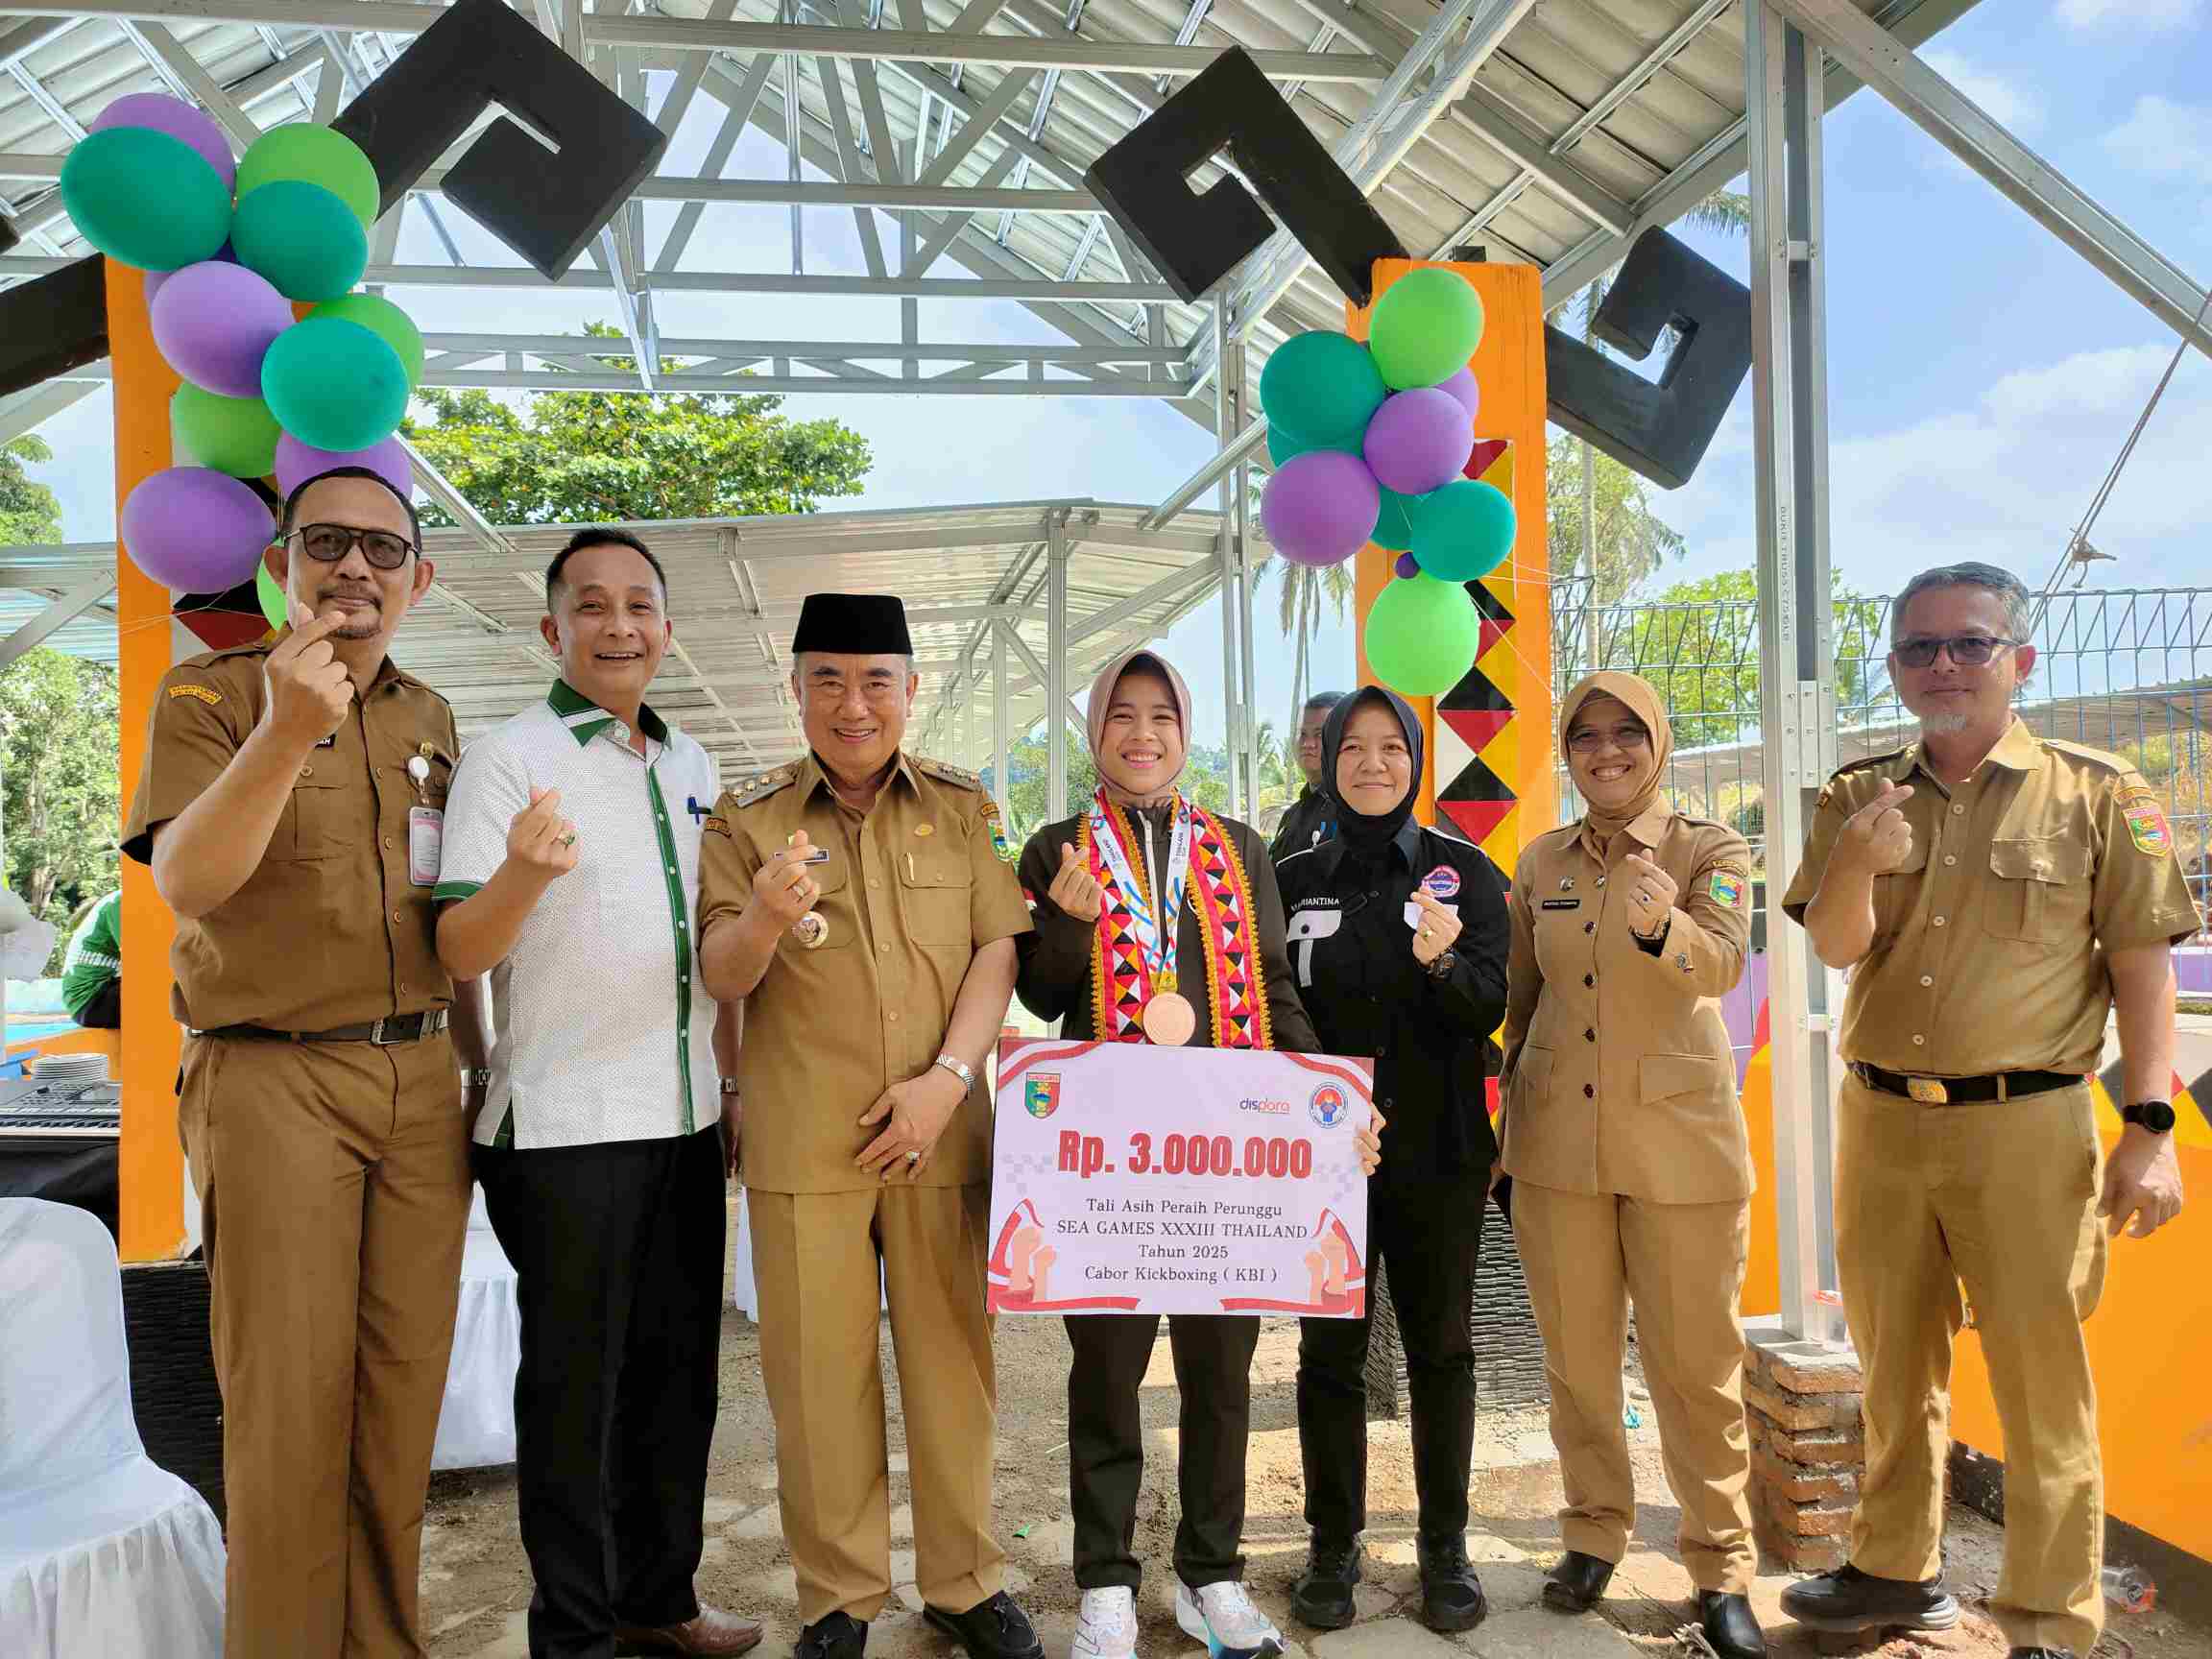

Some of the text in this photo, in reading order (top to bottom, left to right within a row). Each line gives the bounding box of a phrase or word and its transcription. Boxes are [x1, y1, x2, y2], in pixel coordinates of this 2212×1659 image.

[1058, 1130, 1312, 1179] Rp. 3.000.000
[1086, 1197, 1283, 1219] Tali Asih Peraih Perunggu
[1057, 1219, 1308, 1238] SEA GAMES XXXIII THAILAND
[1139, 1244, 1229, 1260] Tahun 2025
[1085, 1266, 1128, 1280] Cabor
[1135, 1267, 1218, 1285] Kickboxing
[1236, 1268, 1265, 1282] KBI
